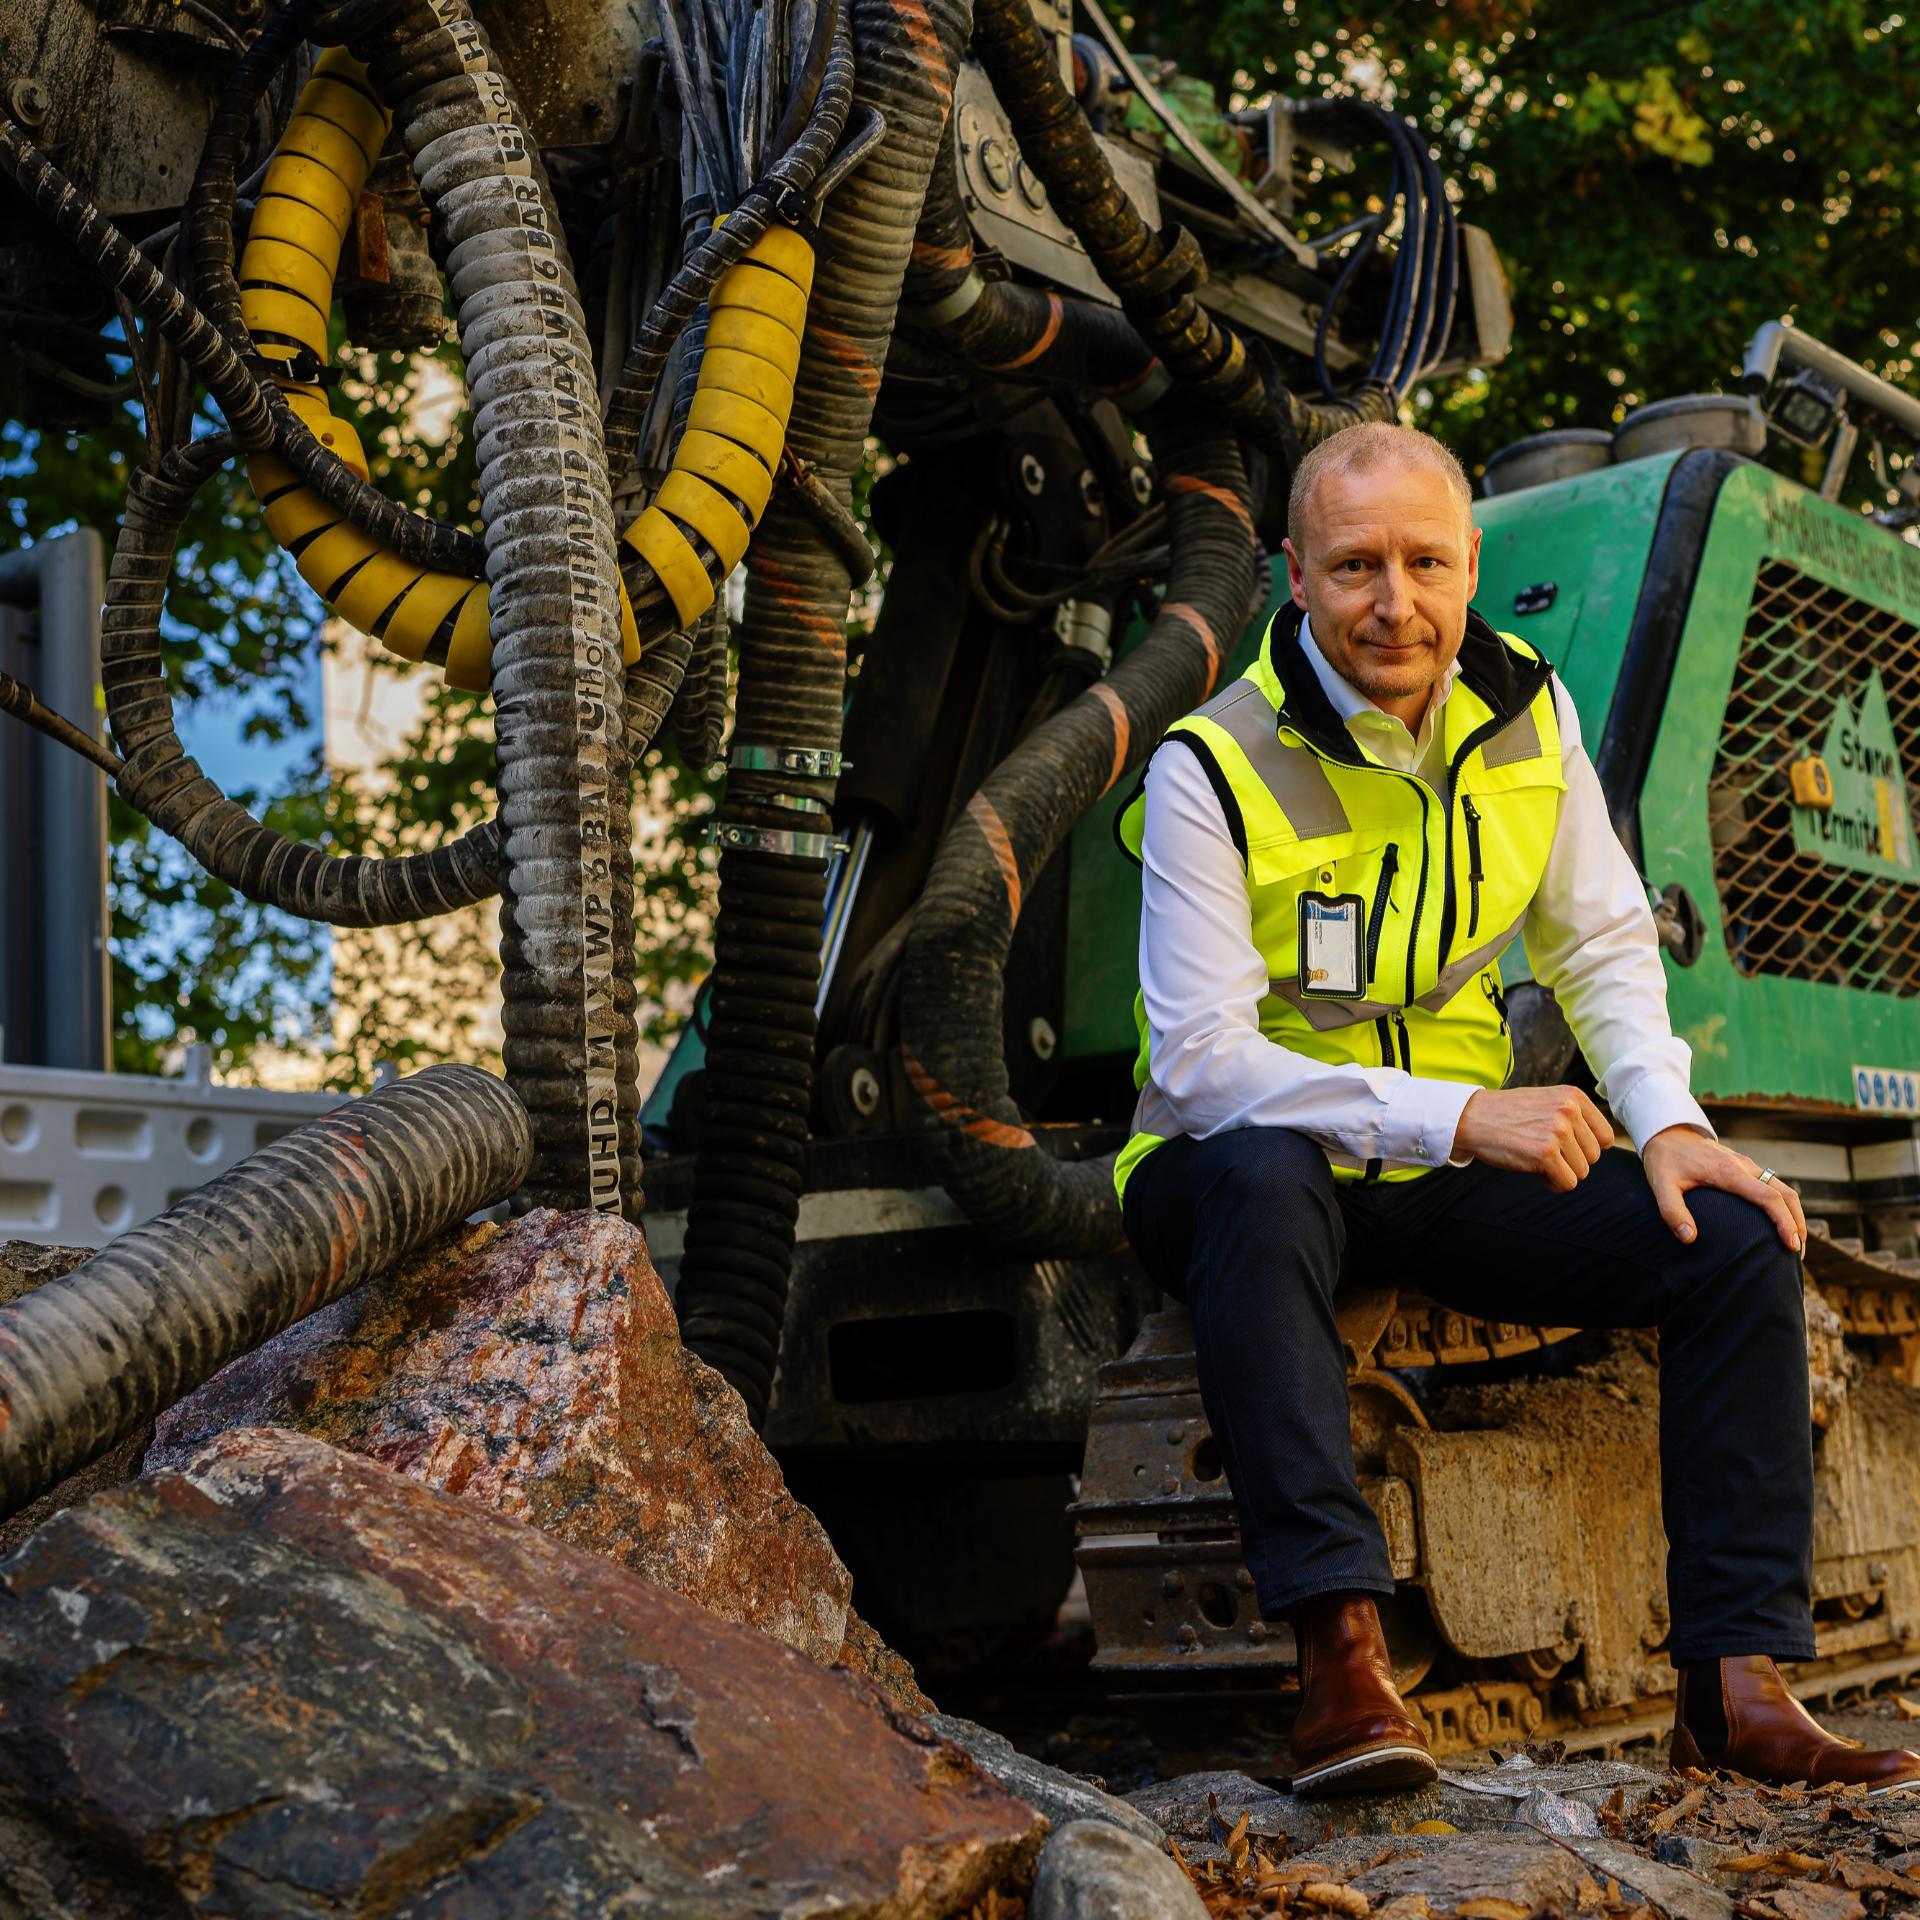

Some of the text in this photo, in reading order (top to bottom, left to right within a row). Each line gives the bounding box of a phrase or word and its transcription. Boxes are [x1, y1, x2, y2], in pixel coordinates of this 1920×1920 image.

[515, 184, 553, 250] BAR
[534, 258, 559, 280] 6
[538, 287, 569, 340] WP
[550, 347, 582, 428] MAX
[1840, 728, 1895, 780] Stone
[582, 858, 609, 881] 6
[584, 893, 611, 959] WP
